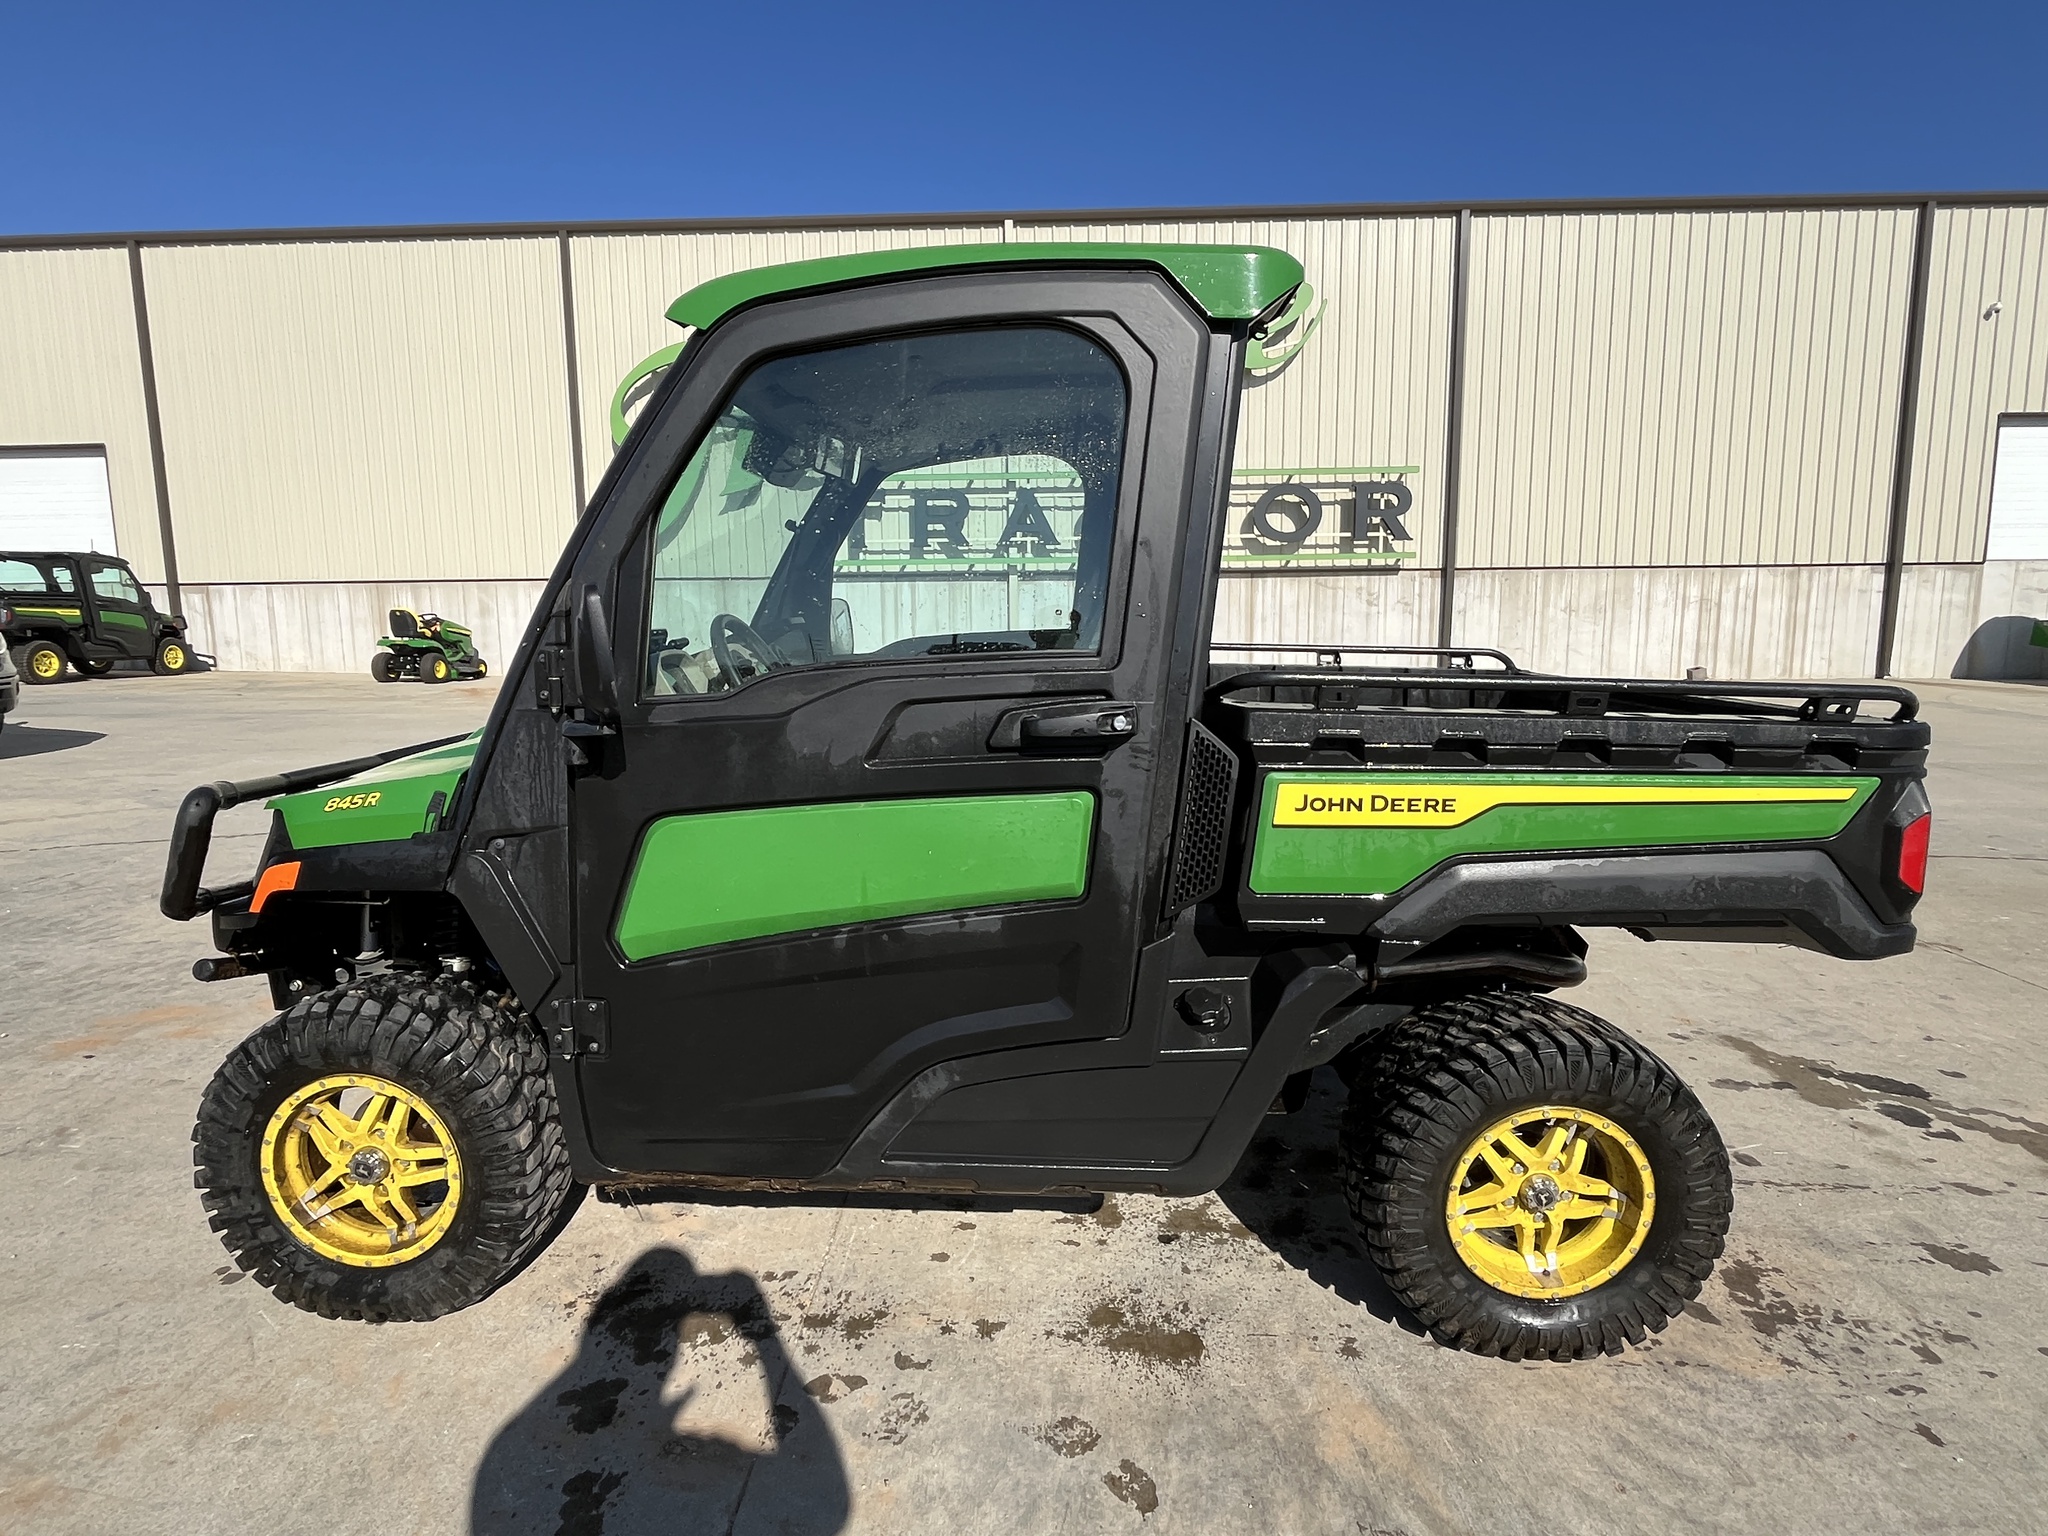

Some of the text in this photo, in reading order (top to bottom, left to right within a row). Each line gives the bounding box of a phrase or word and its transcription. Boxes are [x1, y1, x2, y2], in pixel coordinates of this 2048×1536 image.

[323, 791, 382, 812] 845R
[1294, 793, 1457, 813] JOHN DEERE
